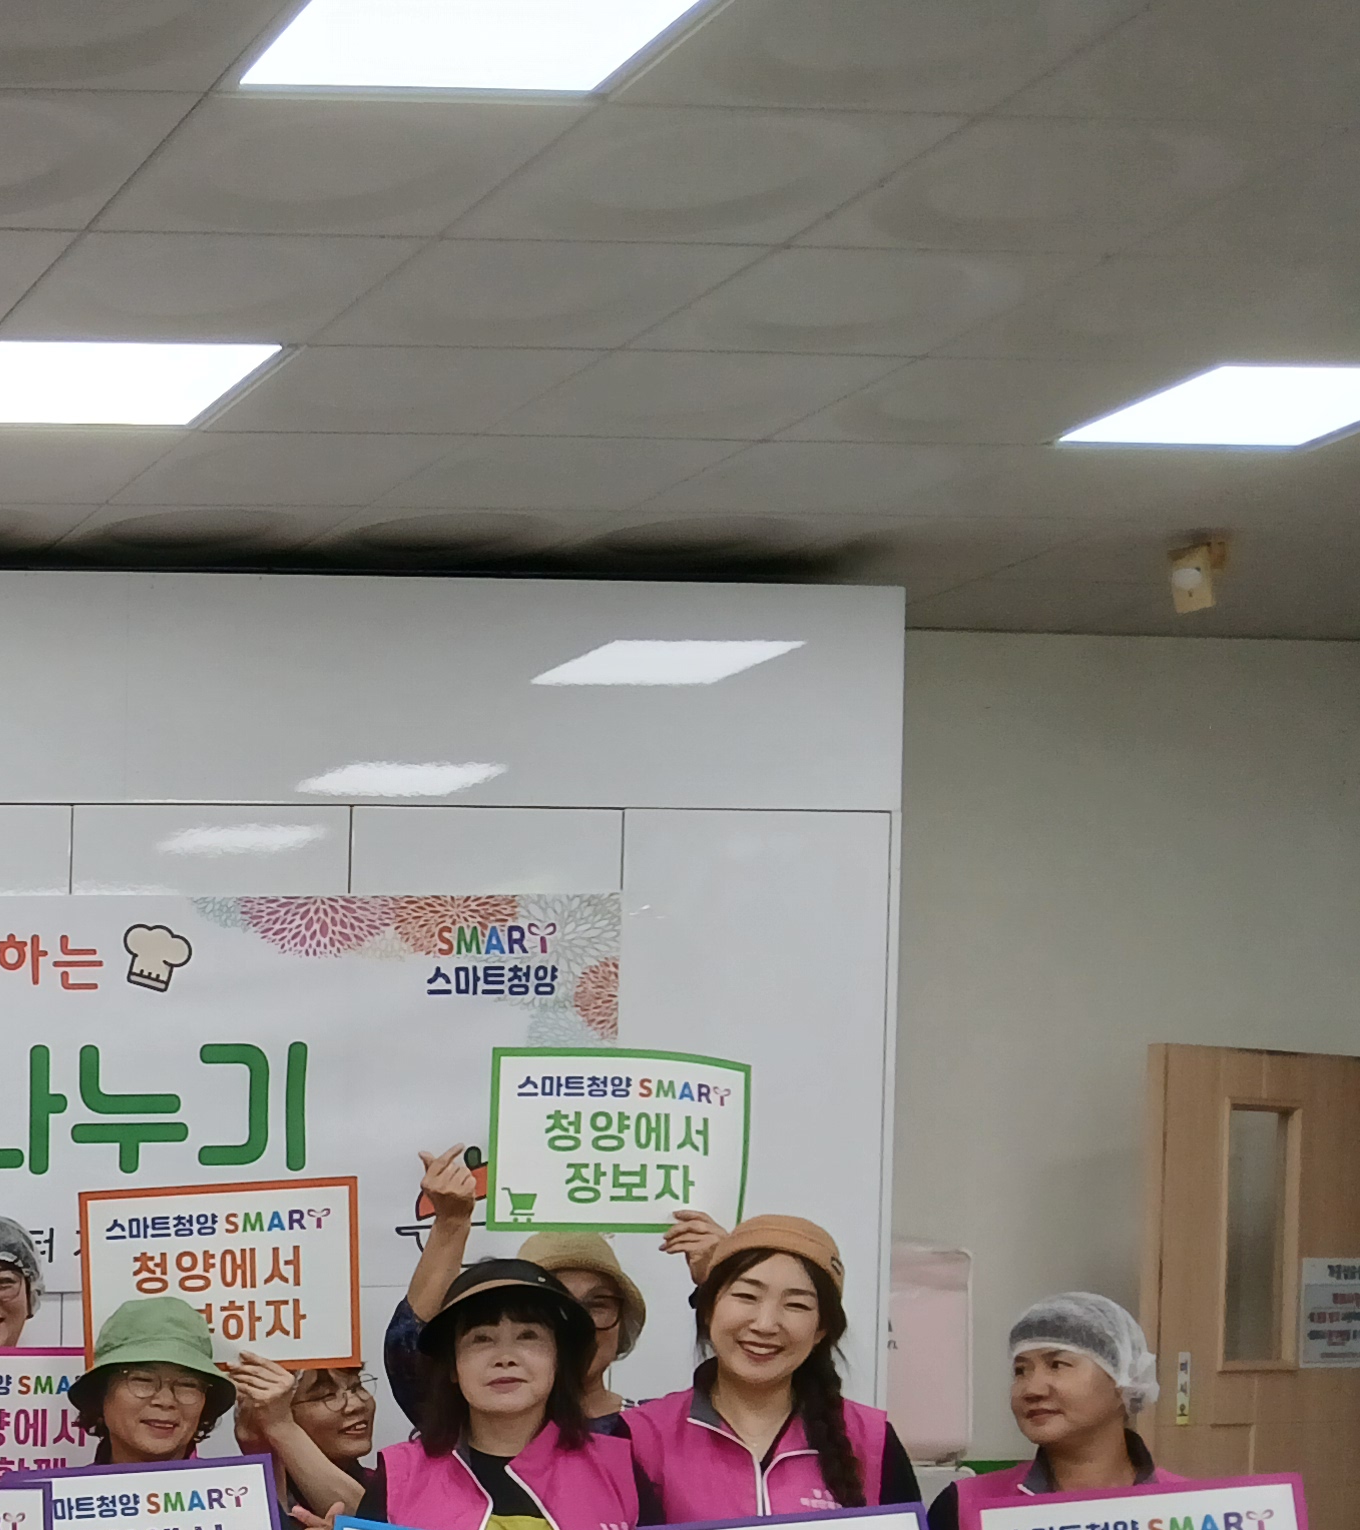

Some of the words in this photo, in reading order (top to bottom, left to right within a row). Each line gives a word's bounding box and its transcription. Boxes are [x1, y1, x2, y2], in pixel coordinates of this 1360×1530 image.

[426, 964, 559, 998] 스마트청양
[517, 1074, 633, 1099] 스마트청양
[544, 1108, 712, 1158] 청양에서
[563, 1160, 696, 1206] 장보자
[105, 1211, 218, 1242] 스마트청양
[131, 1243, 303, 1295] 청양에서
[18, 1375, 80, 1395] SMA
[53, 1493, 141, 1521] 마트청양
